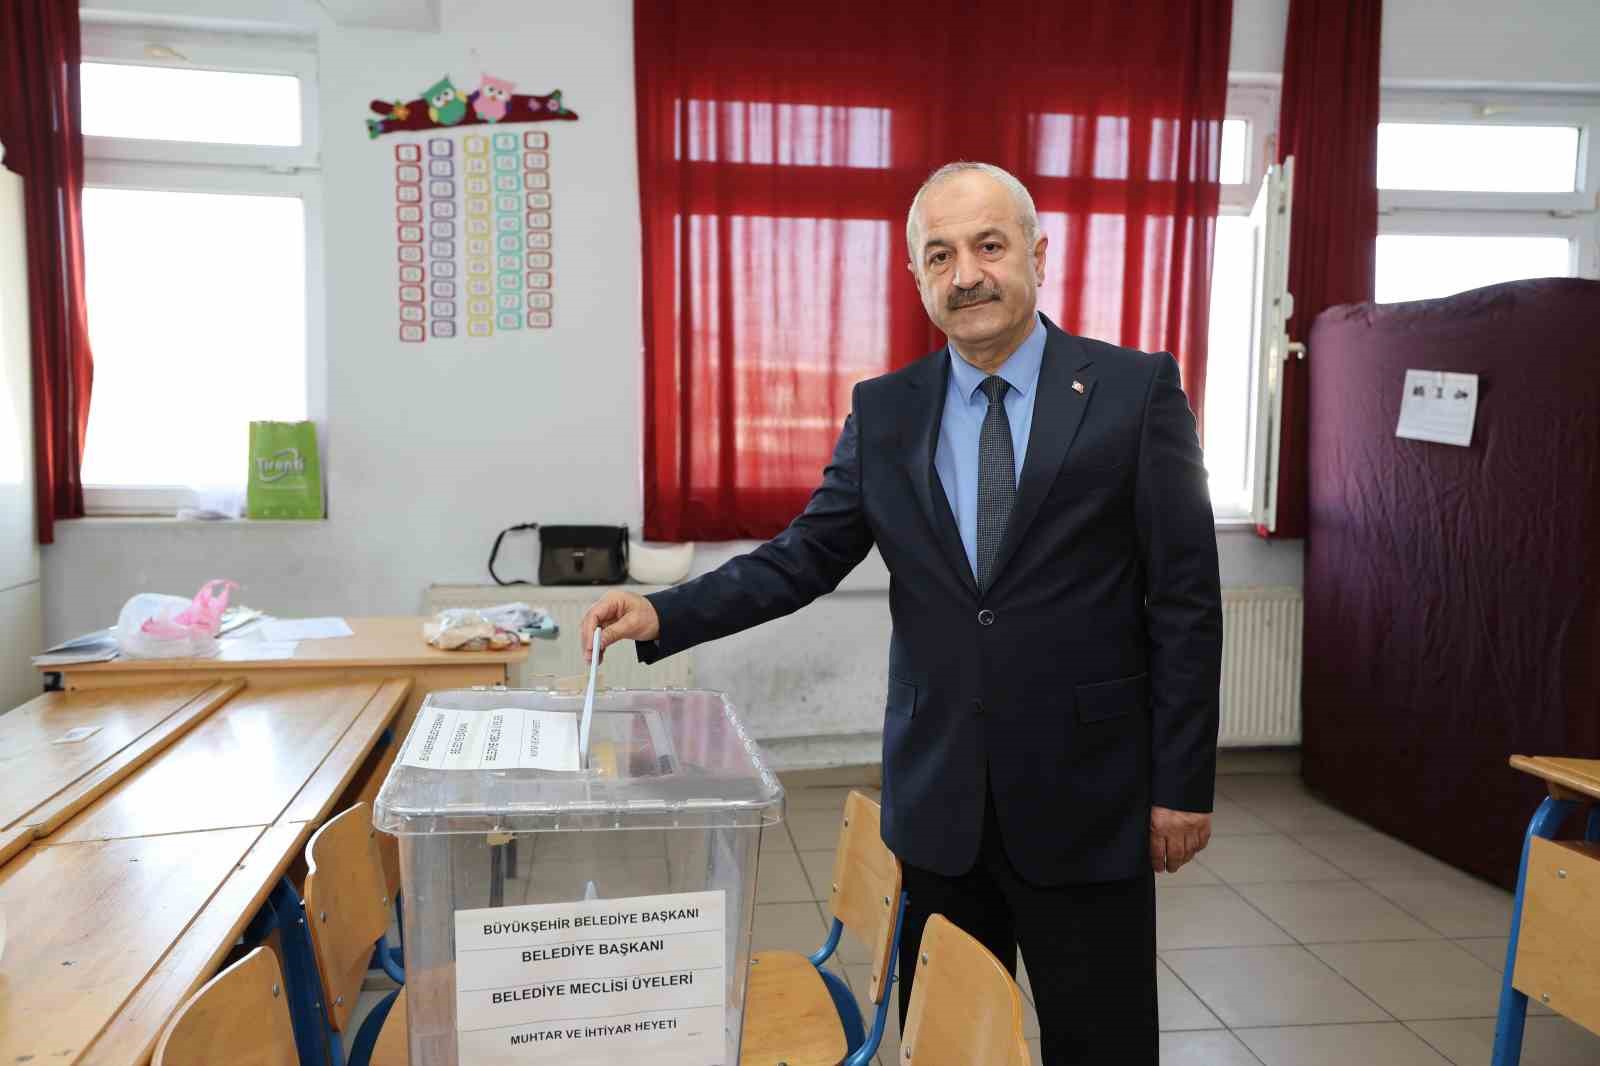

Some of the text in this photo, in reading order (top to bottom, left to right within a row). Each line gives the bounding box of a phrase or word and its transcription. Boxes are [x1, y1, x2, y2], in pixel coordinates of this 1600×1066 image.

[484, 908, 699, 935] BÜYÜKŞEHİR BELEDİYE BAŞKANI
[522, 940, 664, 962] BELEDİYE BAŞKANI
[492, 972, 693, 1004] BELEDİYE MECLİSİ ÜYELERİ
[510, 1019, 677, 1045] MUHTAR VE İHTİYAR HEYETİ
